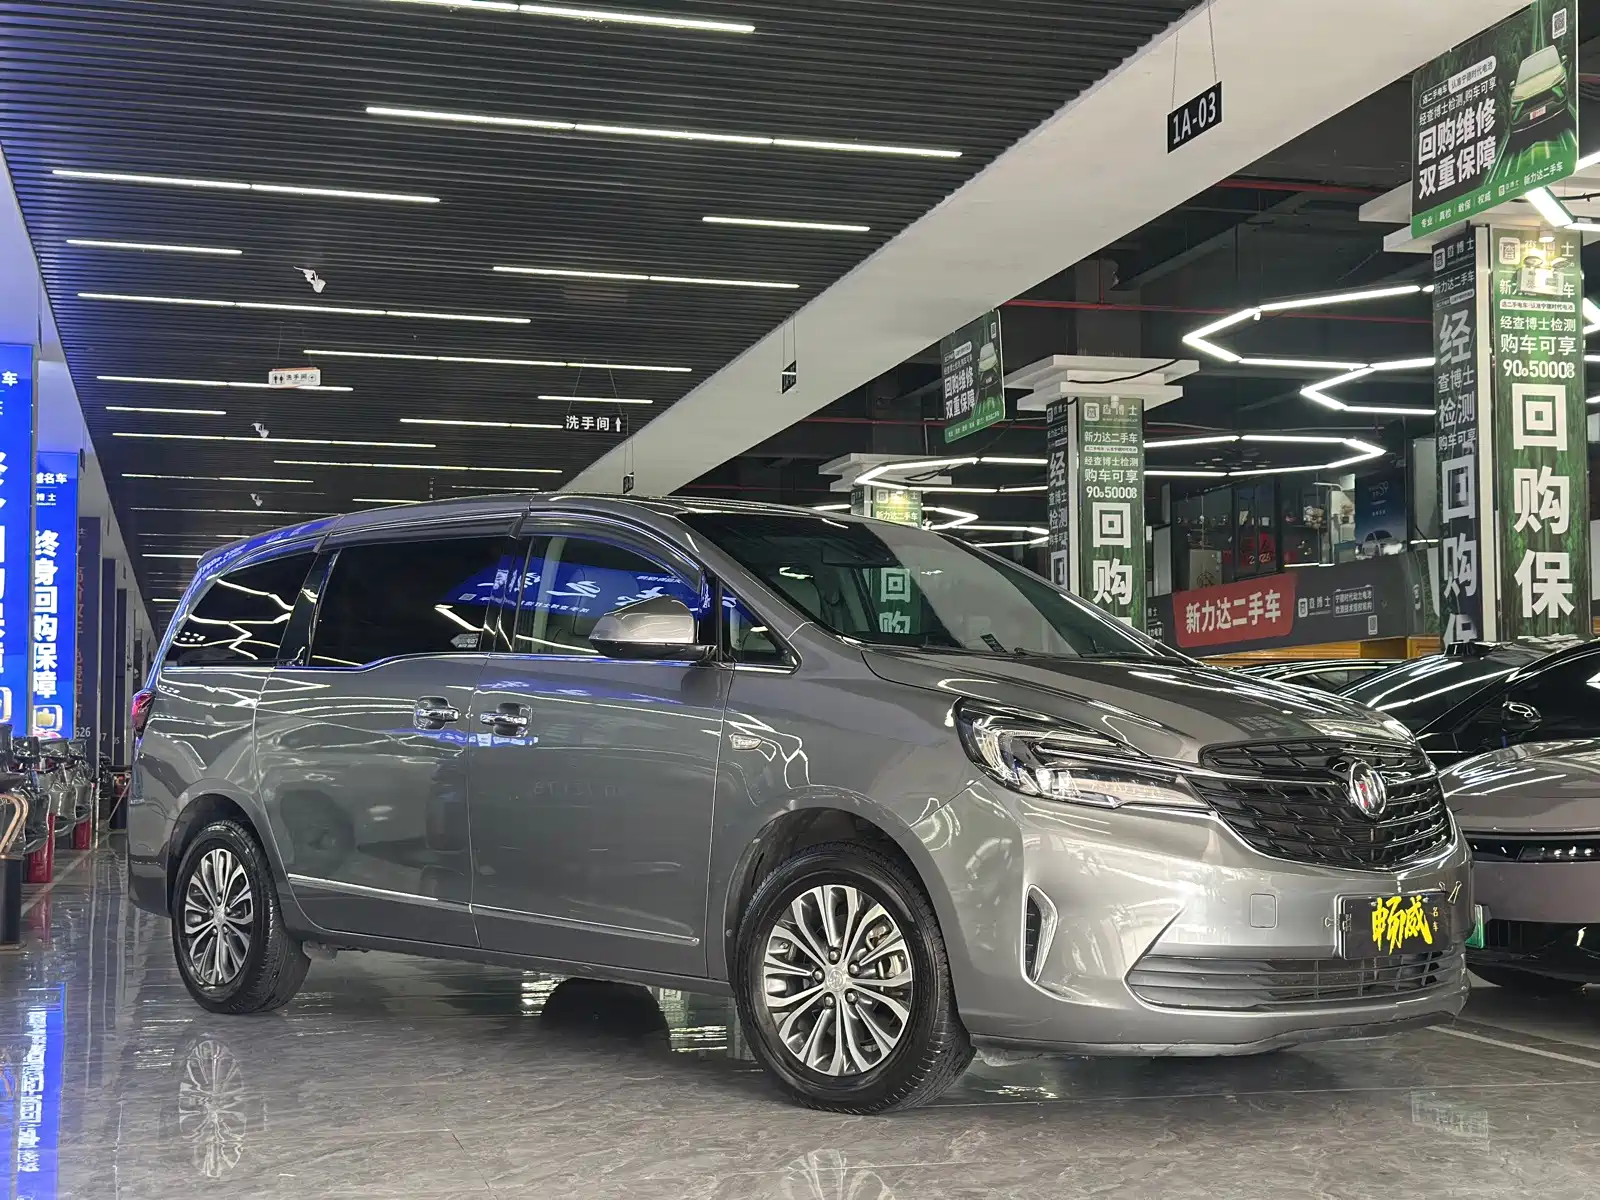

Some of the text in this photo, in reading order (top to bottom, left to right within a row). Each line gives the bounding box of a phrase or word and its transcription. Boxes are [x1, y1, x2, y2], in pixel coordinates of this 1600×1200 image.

[1173, 91, 1216, 144] 1A-03
[1419, 98, 1496, 165] 回购维修
[1419, 135, 1496, 200] 双重保障
[1523, 161, 1563, 187] 新力达二手车
[1439, 310, 1471, 366] 经
[1500, 315, 1576, 332] 经查博士检测
[1501, 333, 1577, 356] 购车可享
[2, 371, 18, 386] 车
[1437, 364, 1474, 393] 查博士
[945, 389, 975, 420] 双重保障
[1438, 390, 1475, 430] 检测
[565, 415, 609, 431] 洗手间
[1085, 431, 1138, 444] 新力达二手车
[1438, 427, 1477, 452] 购车可享
[1084, 469, 1138, 483] 购车可享
[1085, 456, 1139, 467] 经查博士检测
[1512, 383, 1575, 618] 回购保
[33, 529, 60, 699] 终身回购保障
[1186, 589, 1281, 634] 新力达二手车
